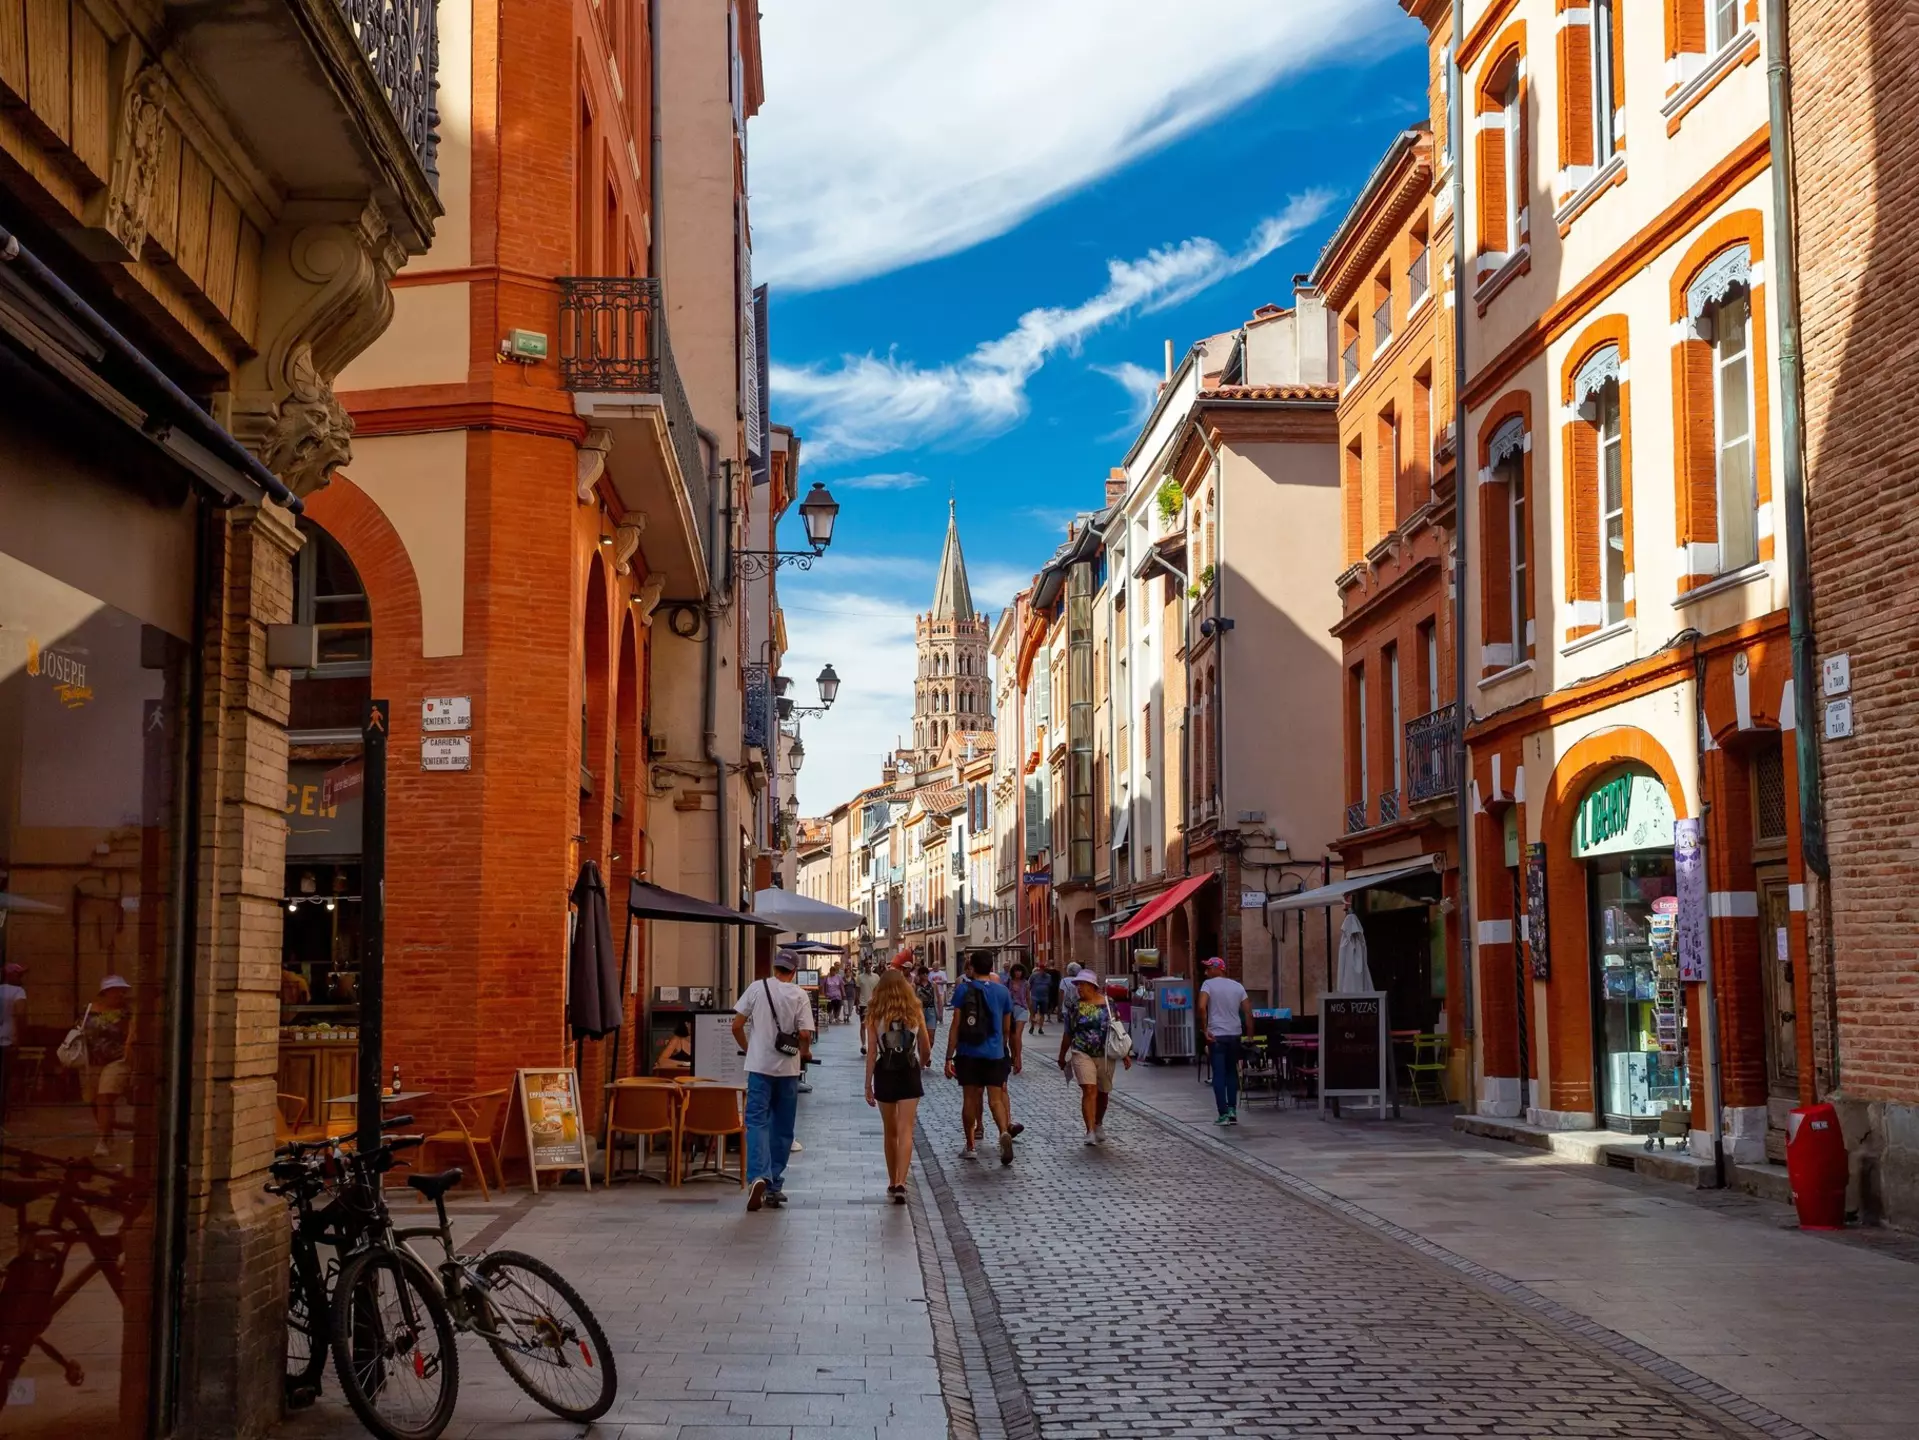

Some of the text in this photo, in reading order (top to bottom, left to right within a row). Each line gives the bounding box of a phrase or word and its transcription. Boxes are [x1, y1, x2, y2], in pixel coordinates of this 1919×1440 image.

[42, 650, 86, 688] JOSEPH
[1832, 661, 1840, 670] RUE
[1833, 675, 1844, 687] TAUR
[439, 698, 453, 706] RUE
[423, 716, 452, 726] PENITENTS
[1832, 722, 1845, 733] TAUR
[430, 738, 461, 746] CARRIERA
[1330, 1001, 1378, 1014] NOS PIZZAS
